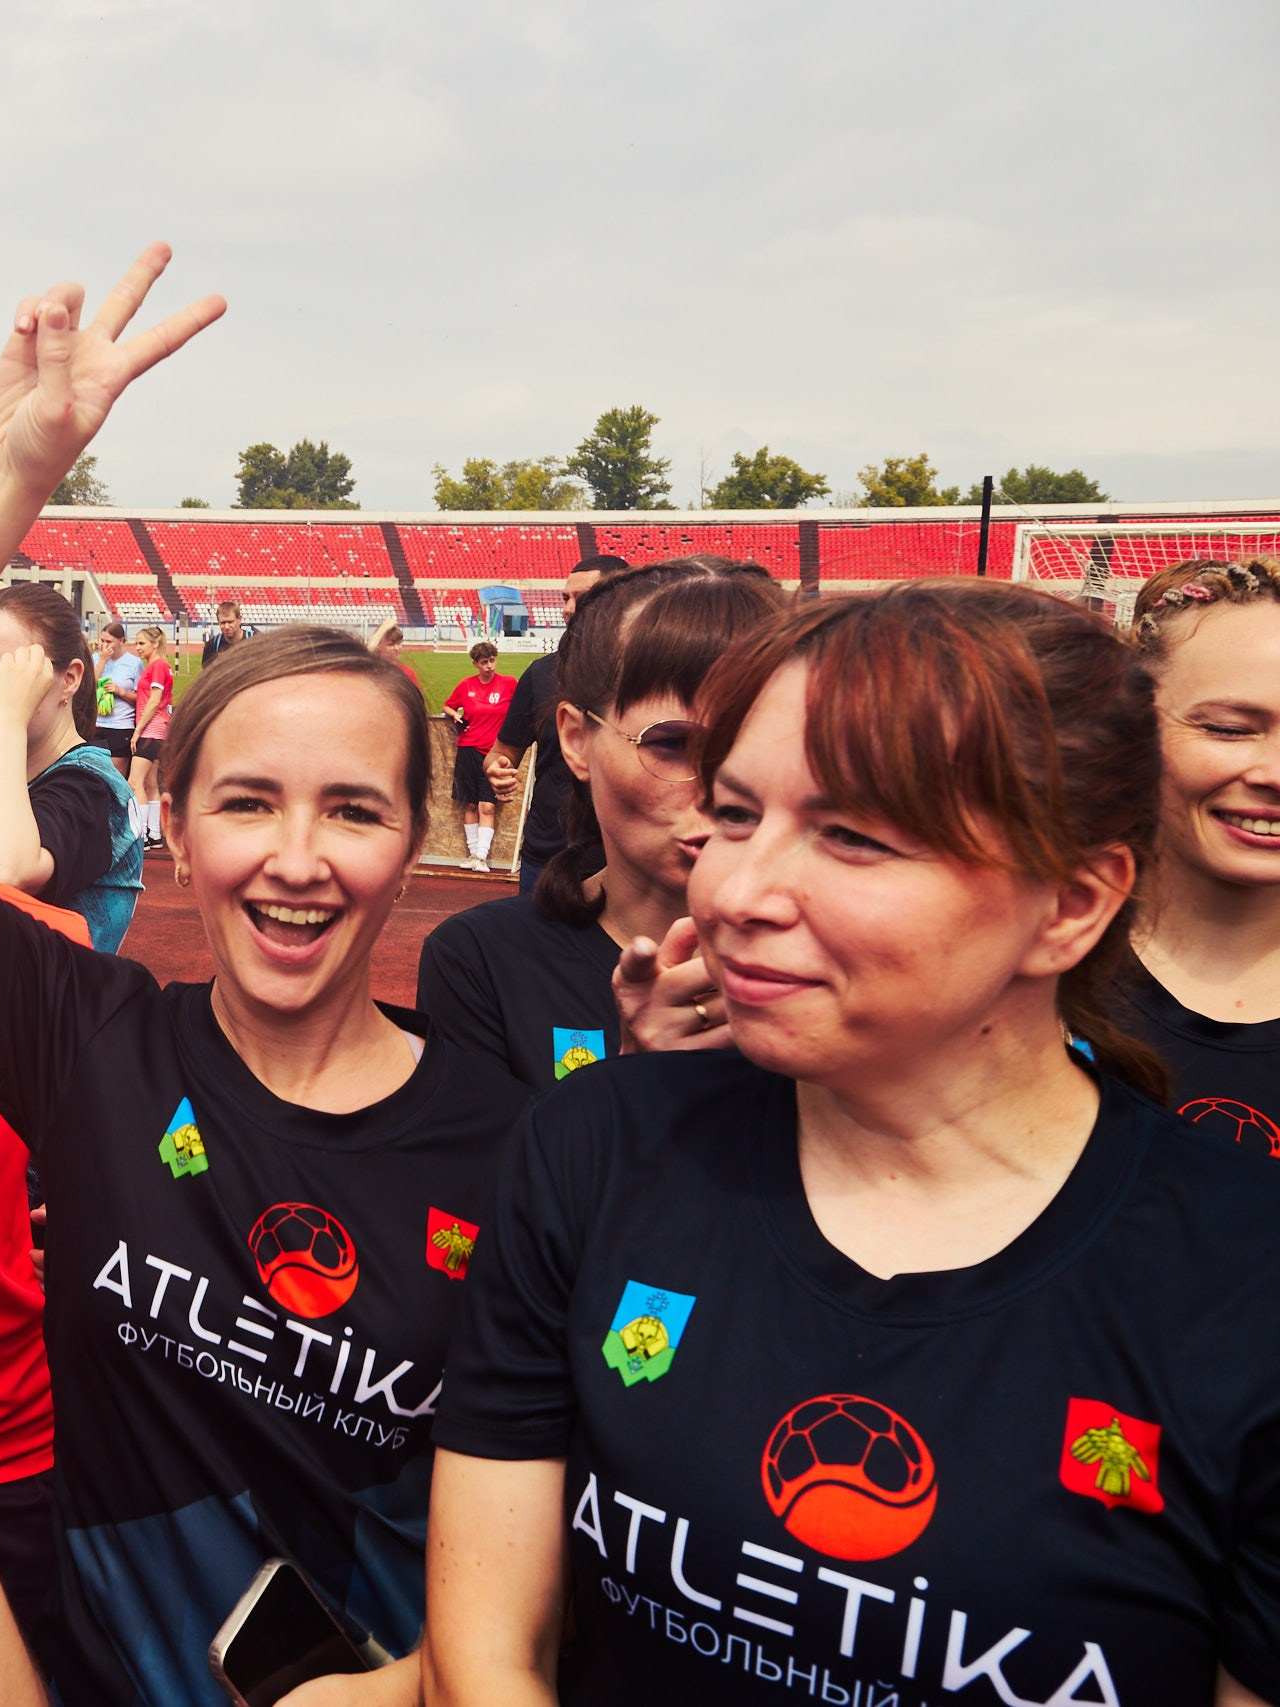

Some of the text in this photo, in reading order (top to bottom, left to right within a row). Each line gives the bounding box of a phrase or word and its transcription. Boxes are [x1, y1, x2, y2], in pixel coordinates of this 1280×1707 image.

[488, 692, 501, 704] 69
[117, 1321, 412, 1450] ФУТБОЛЬНЫЙ КЛУБ
[600, 1575, 900, 1707] ФУТБОЛЬНЫЙ
